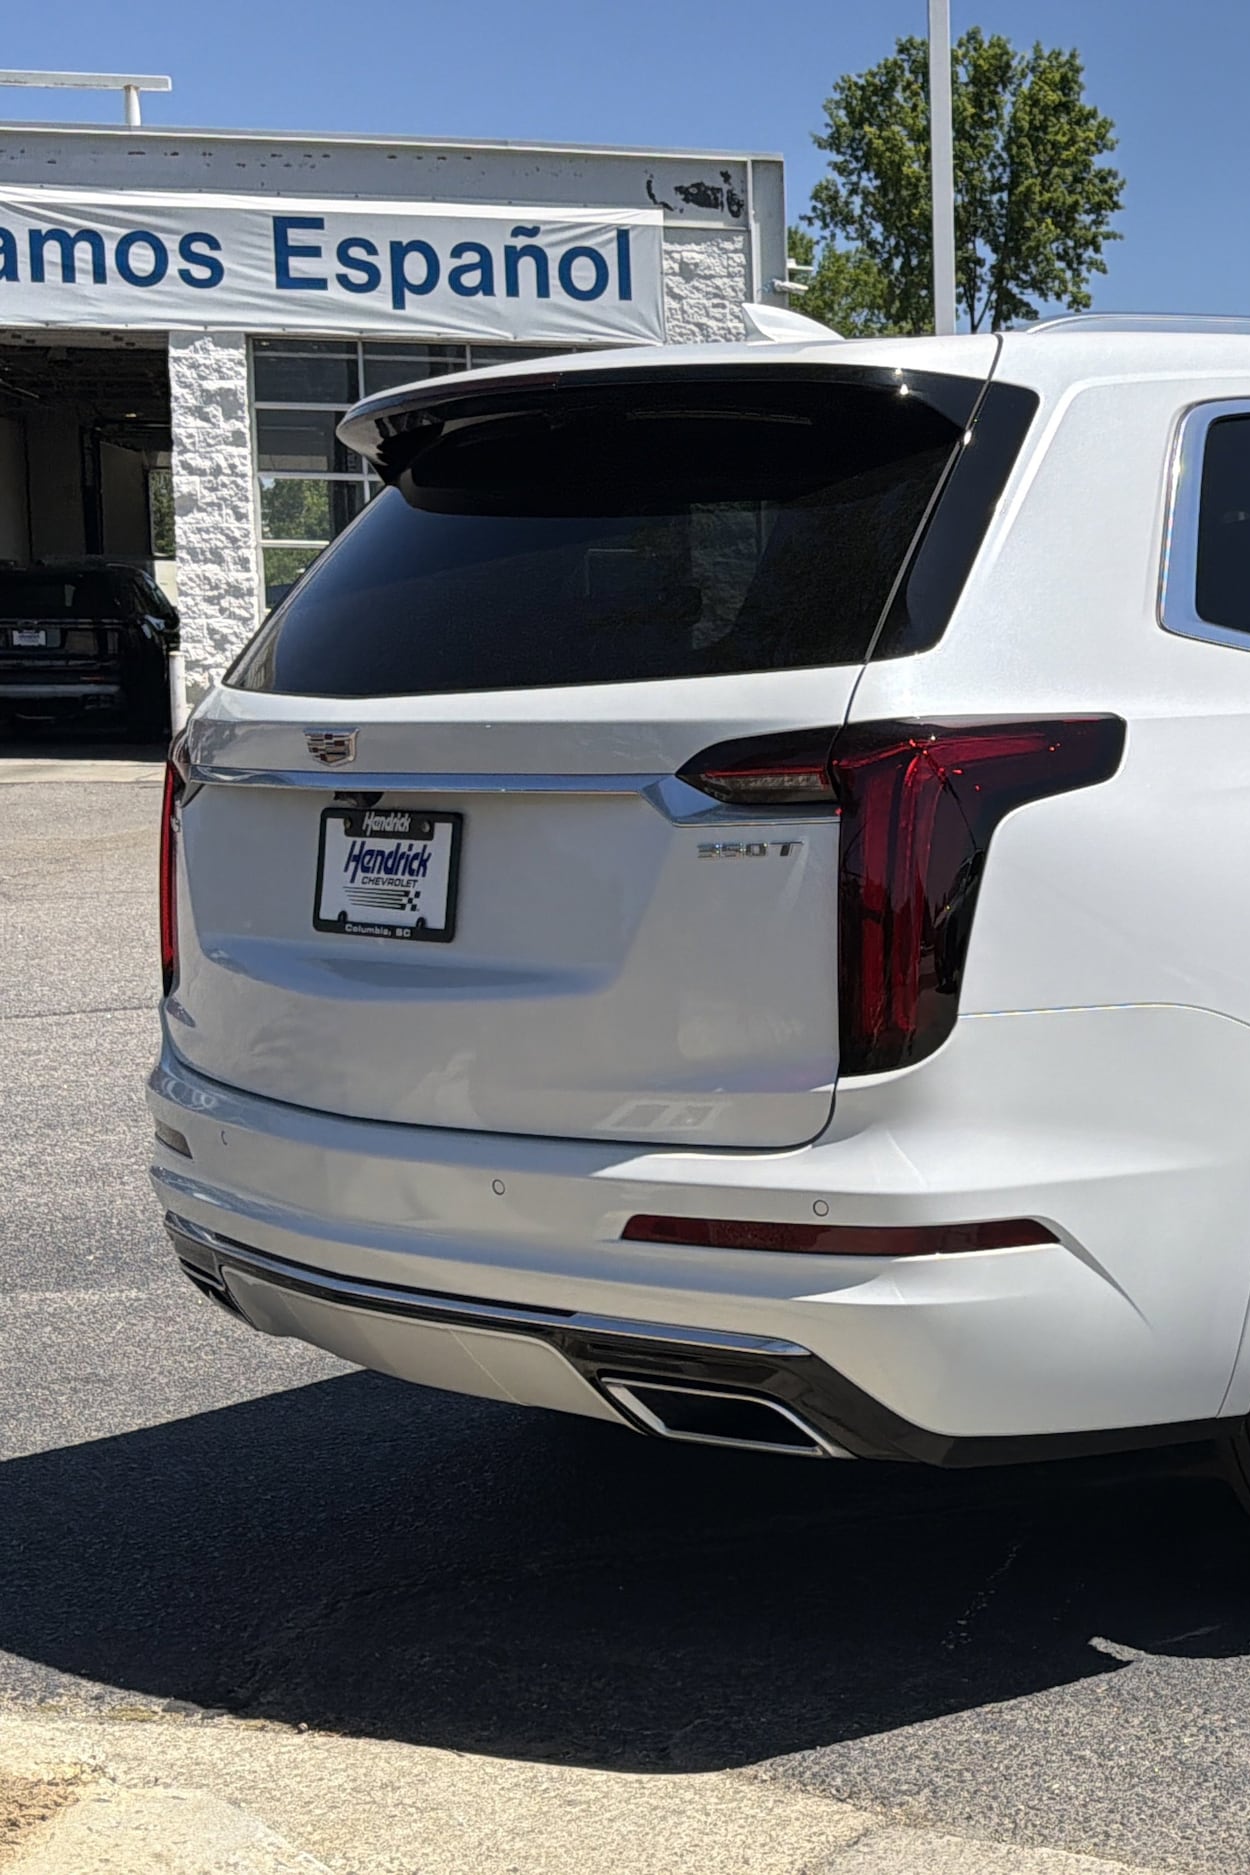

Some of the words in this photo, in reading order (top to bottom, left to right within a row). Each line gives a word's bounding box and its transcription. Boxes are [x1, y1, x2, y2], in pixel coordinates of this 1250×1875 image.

[272, 216, 633, 310] Español
[362, 811, 411, 836] Hendrick
[343, 840, 432, 884] Hendrick
[361, 876, 418, 889] CHEVROLET
[345, 924, 392, 937] Columbia,
